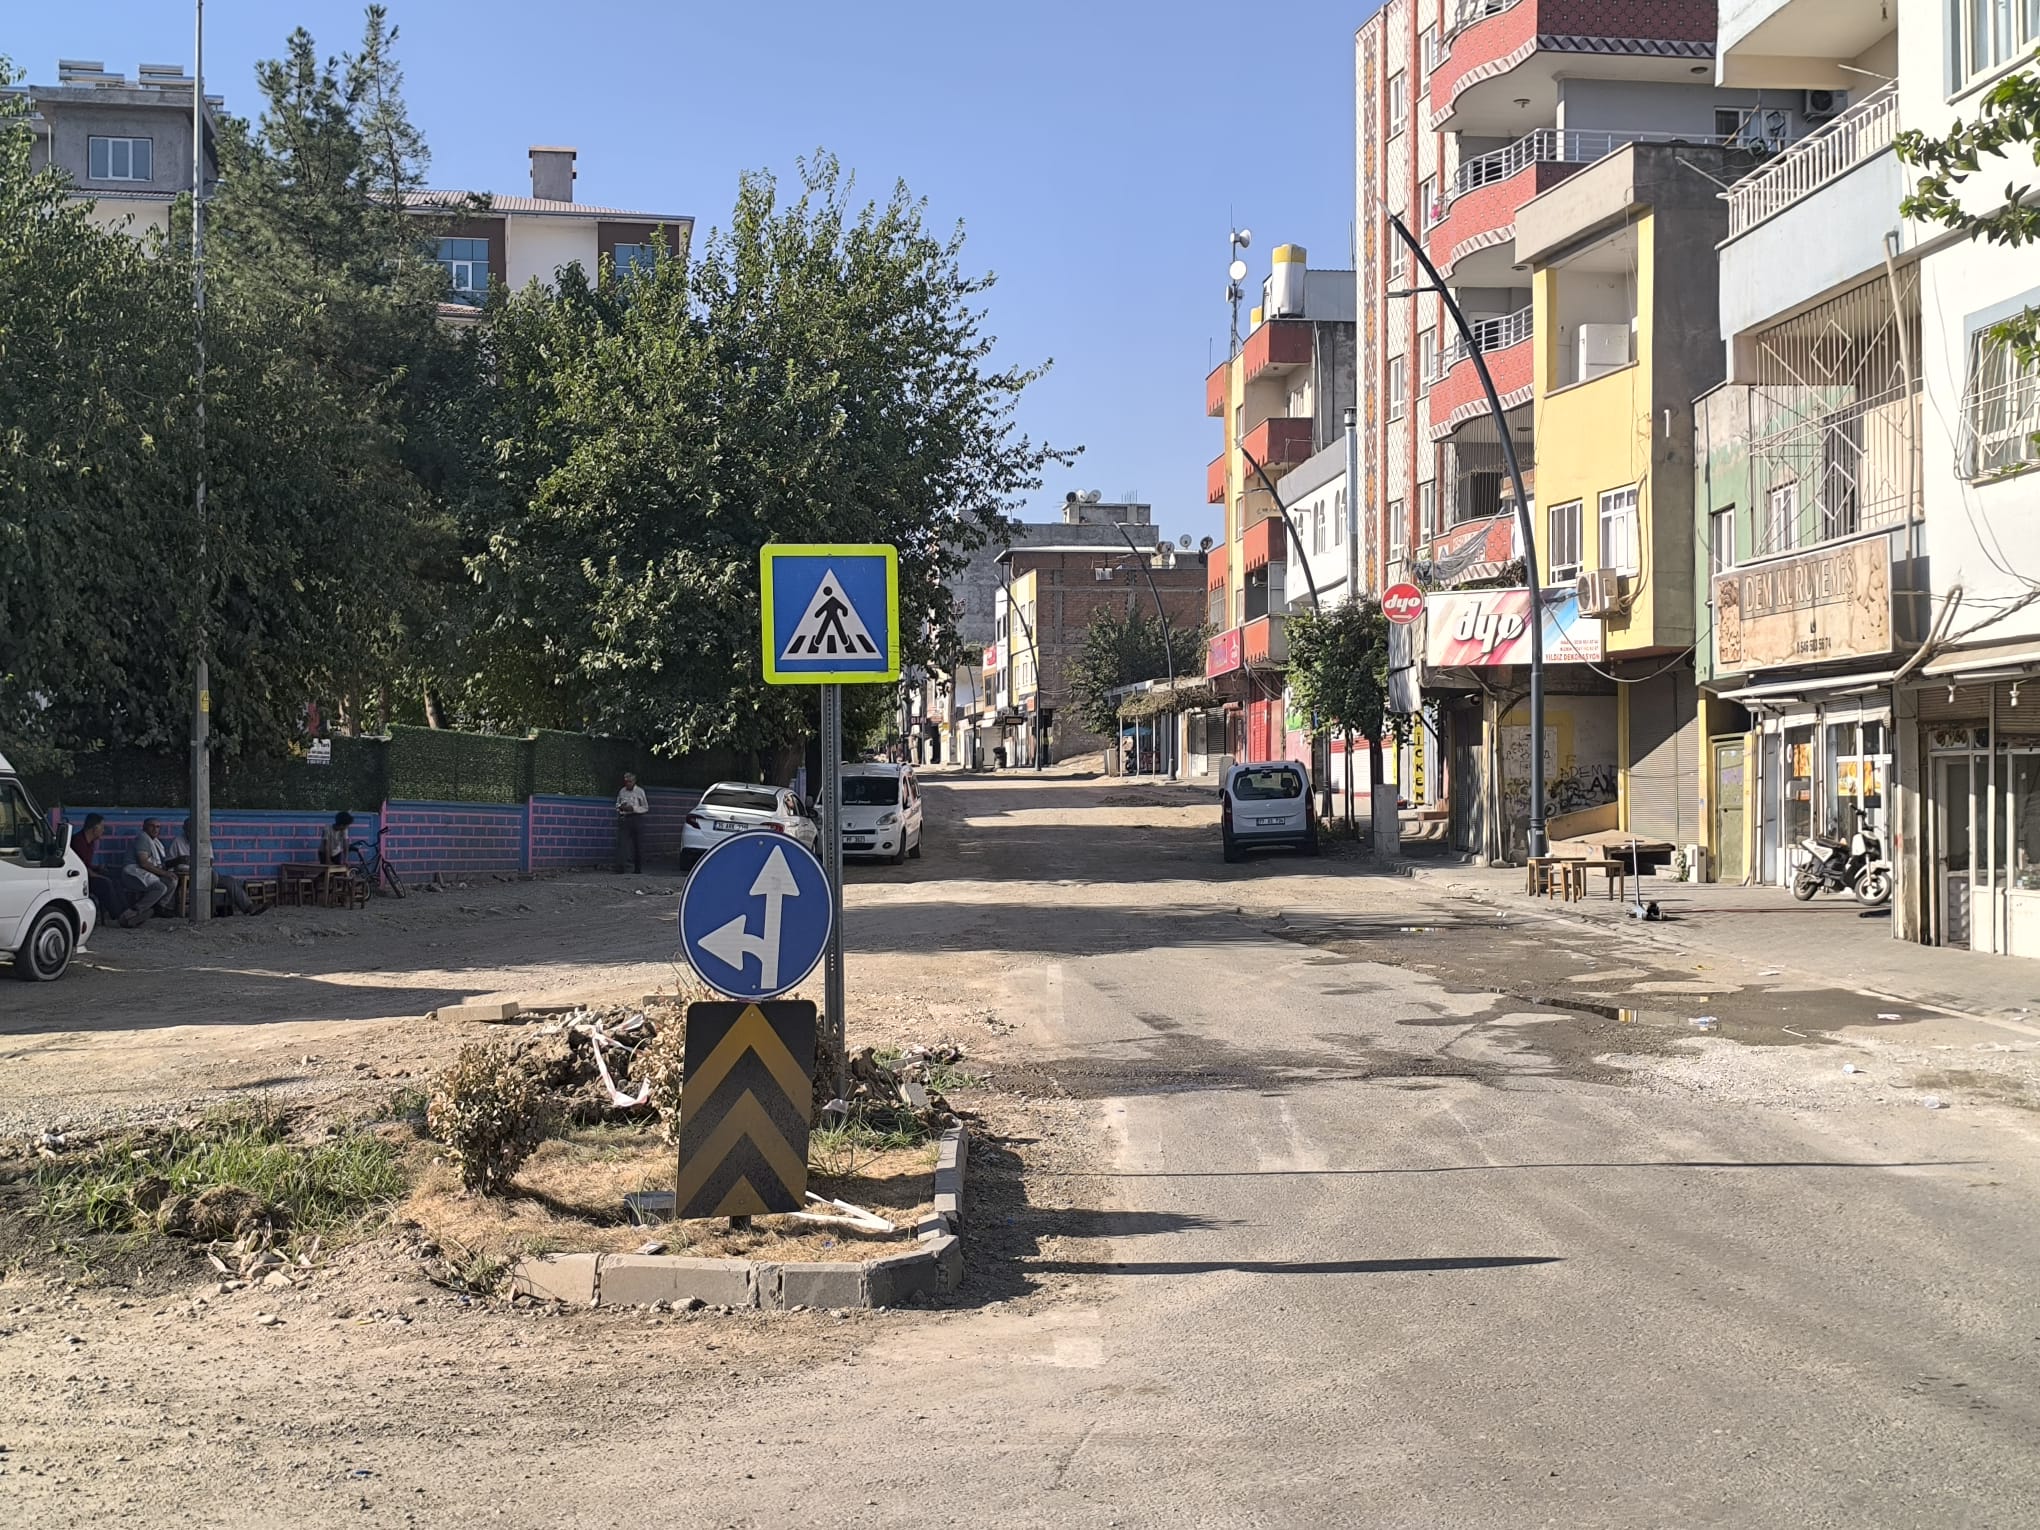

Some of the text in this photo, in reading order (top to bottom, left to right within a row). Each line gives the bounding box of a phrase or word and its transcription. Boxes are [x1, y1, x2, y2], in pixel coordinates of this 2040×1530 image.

[1384, 594, 1421, 613] dyo
[1743, 571, 1773, 613] DEM
[1453, 600, 1526, 654] dyo
